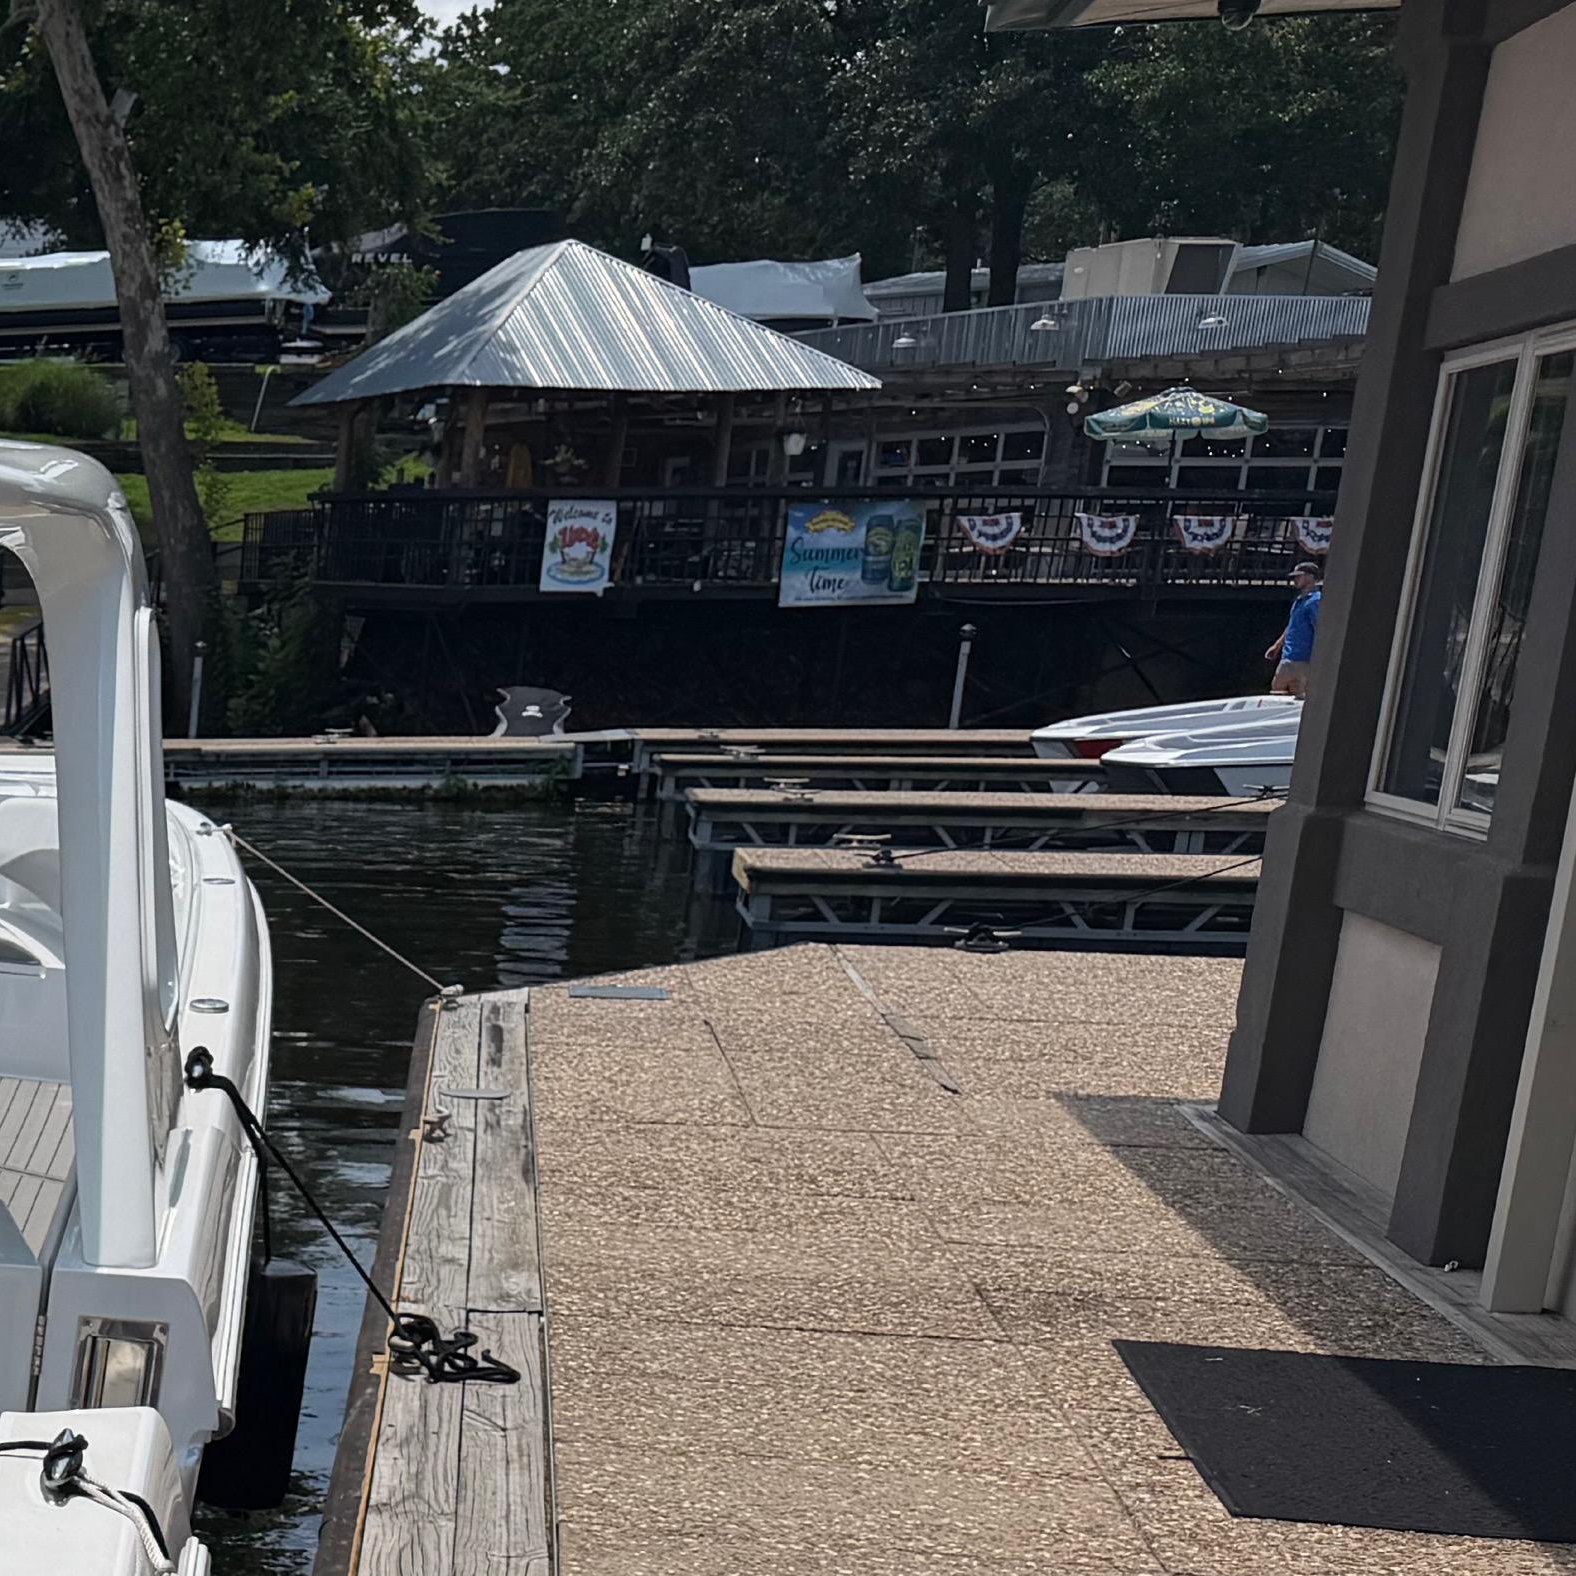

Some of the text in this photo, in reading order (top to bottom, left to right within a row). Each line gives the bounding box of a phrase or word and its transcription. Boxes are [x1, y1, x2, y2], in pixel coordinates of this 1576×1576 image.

[351, 253, 413, 263] REVEL
[790, 536, 863, 565] Summer
[807, 566, 845, 593] Time
